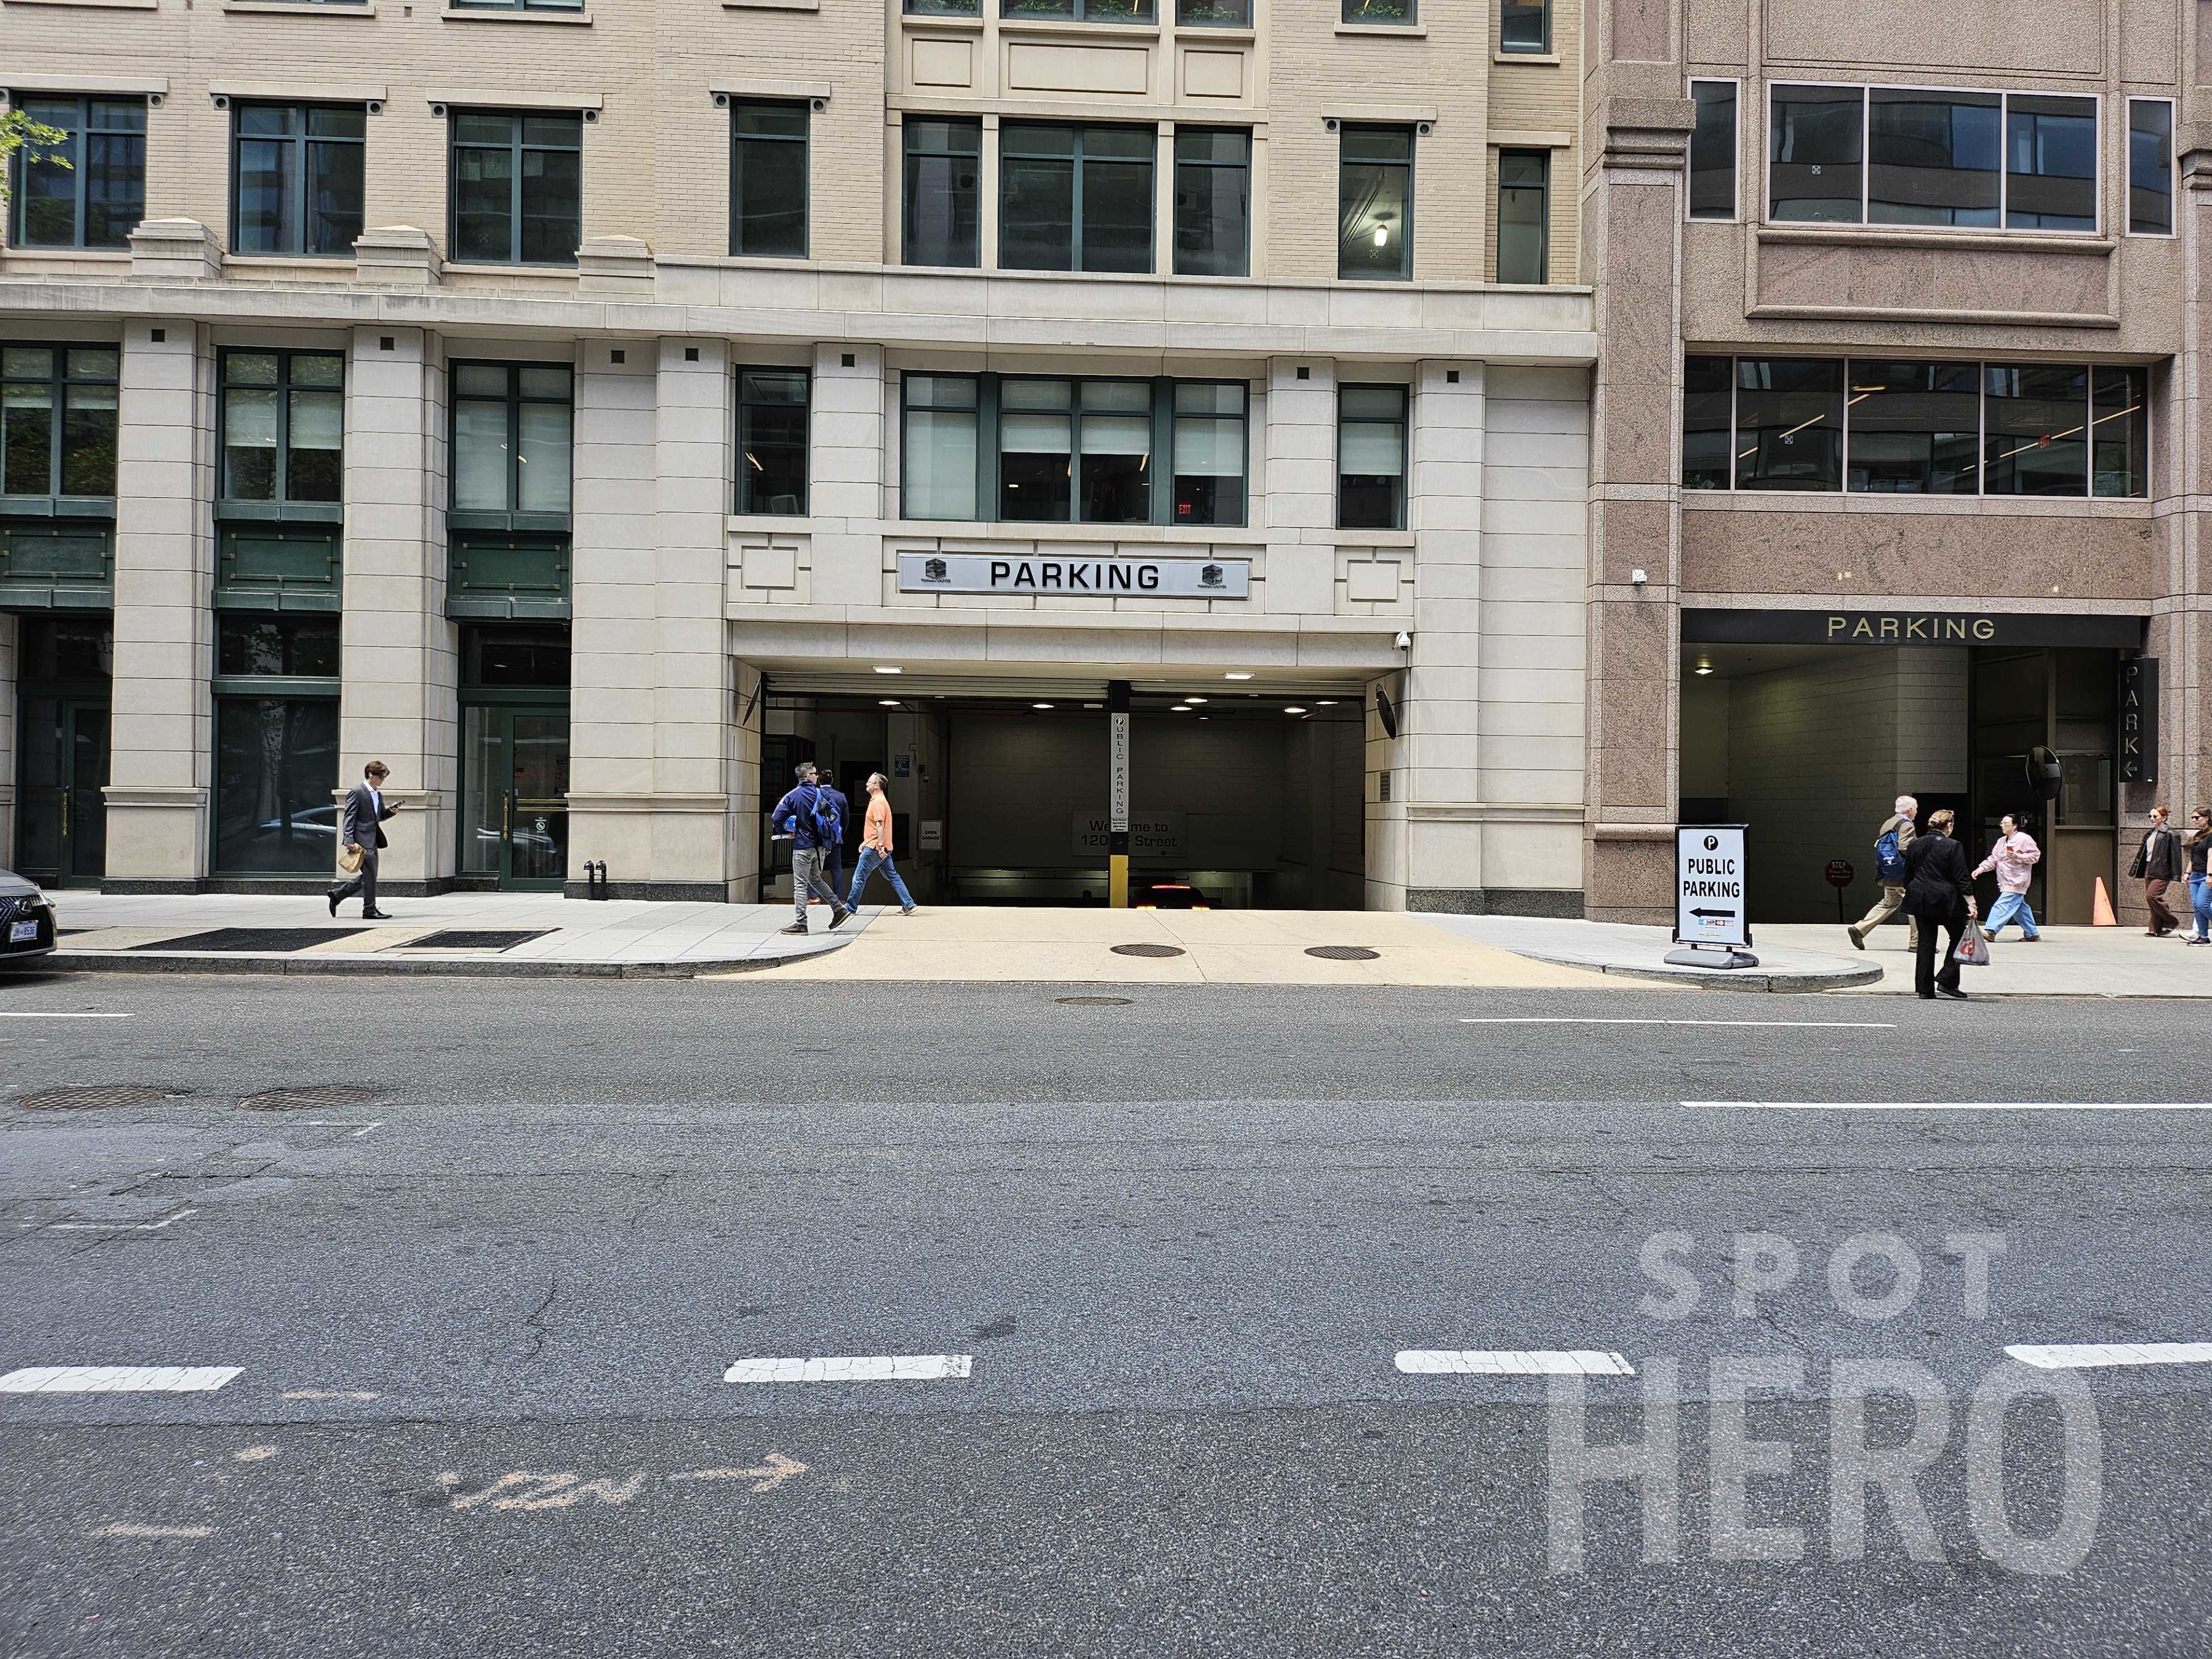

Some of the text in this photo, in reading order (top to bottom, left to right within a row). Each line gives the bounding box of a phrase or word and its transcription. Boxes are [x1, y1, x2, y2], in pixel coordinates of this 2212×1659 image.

[1179, 505, 1191, 514] EXIT
[991, 562, 1158, 589] PARKING
[1828, 617, 1994, 639] PARKING
[2125, 666, 2139, 754] PARK
[1116, 767, 1124, 814] PARKING
[1154, 823, 1168, 832] to
[1081, 835, 1109, 846] 120
[1135, 836, 1177, 847] Street
[1688, 858, 1735, 875] PUBLIC
[1684, 881, 1740, 898] PARKING
